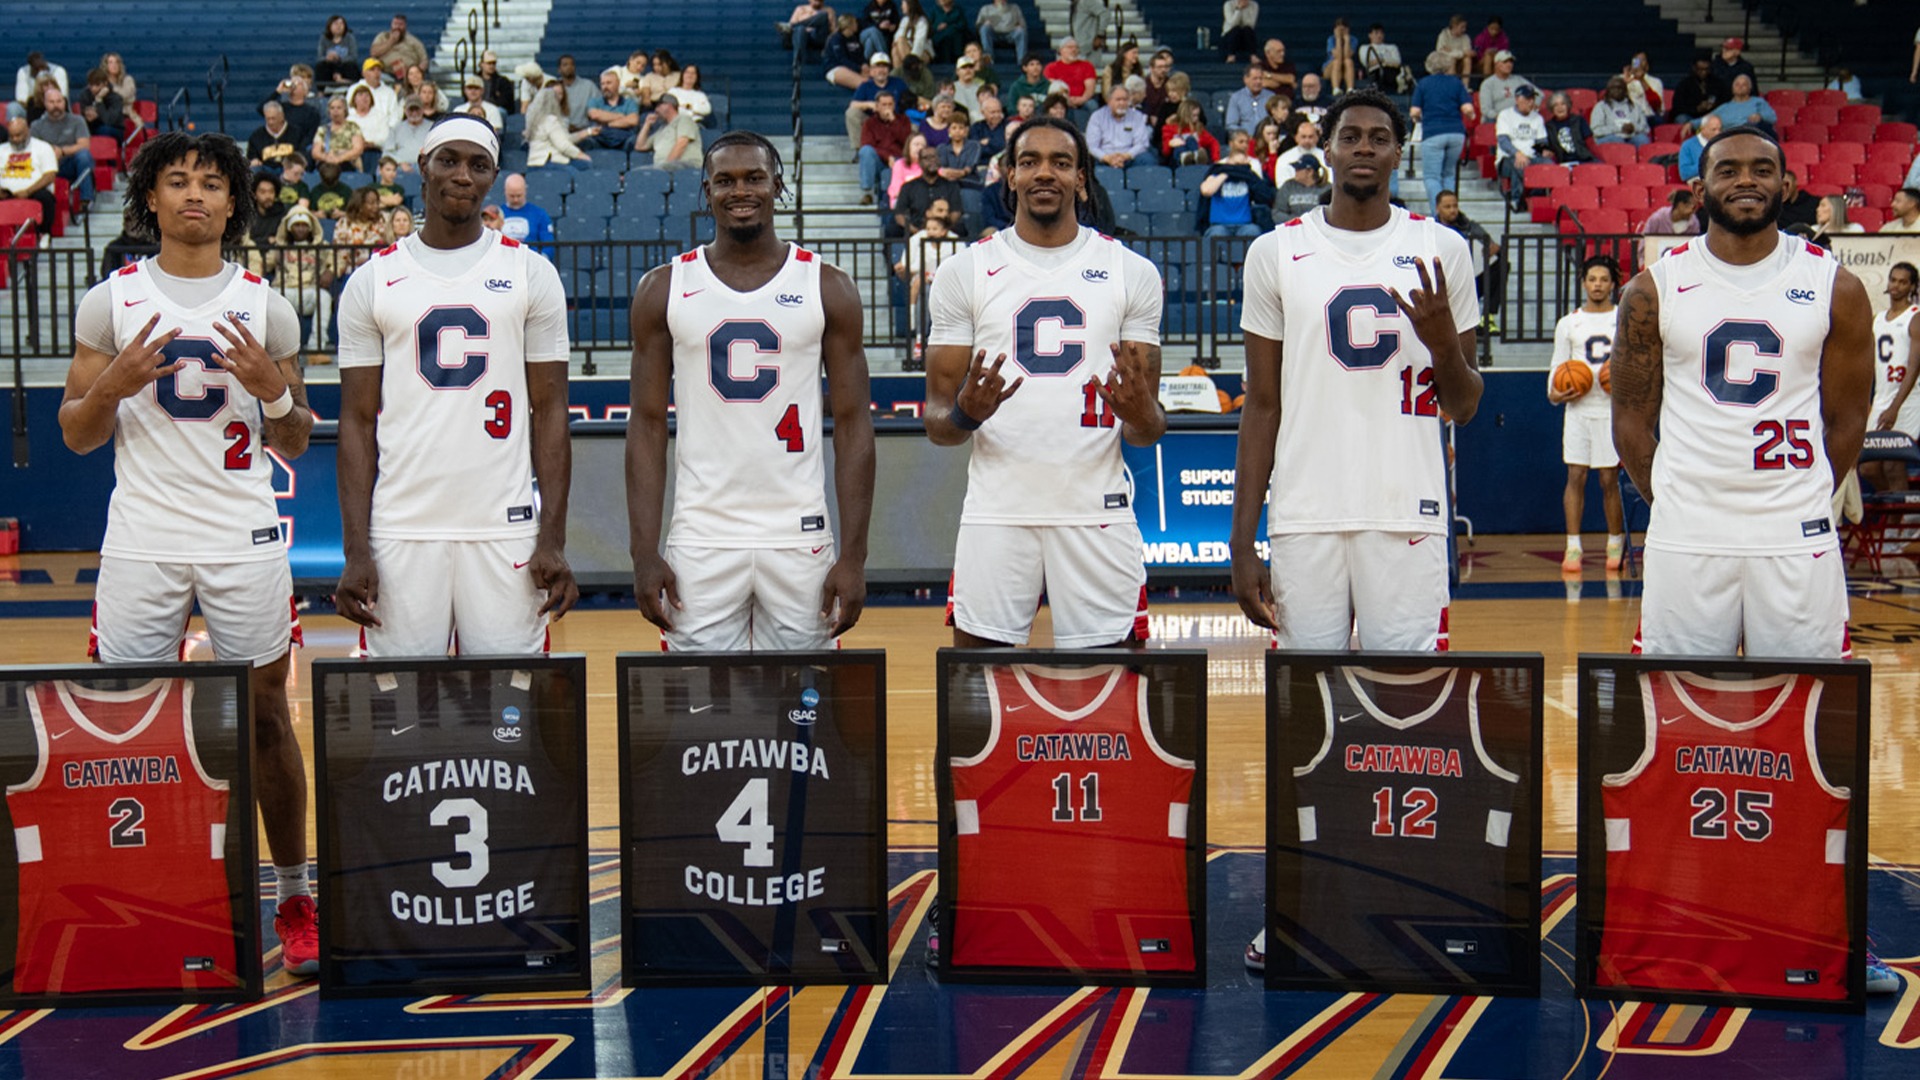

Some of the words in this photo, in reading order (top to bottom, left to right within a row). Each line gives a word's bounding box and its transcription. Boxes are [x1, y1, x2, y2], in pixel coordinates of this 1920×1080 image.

[488, 279, 512, 289] SAC
[1086, 269, 1109, 280] SAC
[780, 294, 803, 304] SAC
[1790, 289, 1815, 301] SAC
[415, 304, 490, 390] C
[1013, 296, 1086, 377] C
[1325, 284, 1401, 371] C
[706, 319, 781, 403] C
[1585, 335, 1612, 365] C
[1701, 318, 1784, 408] C
[1878, 334, 1893, 363] C
[153, 336, 229, 422] C
[1168, 383, 1208, 391] BASKETBALL
[1401, 366, 1439, 417] 12
[1887, 365, 1906, 383] 23
[484, 390, 512, 439] 3
[775, 404, 804, 452] 4
[223, 421, 252, 470] 2
[1753, 420, 1815, 470] 25
[1863, 437, 1913, 449] CATAWBA
[1180, 469, 1236, 485] SUPPO
[1181, 490, 1234, 505] STUDE
[1142, 541, 1232, 563] WBA.ED
[497, 727, 521, 738] SAC
[793, 710, 817, 721] SAC
[682, 739, 829, 779] CATAWBA
[1017, 734, 1131, 761] CATAWBA
[1345, 744, 1463, 777] CATAWBA
[1676, 746, 1794, 781] CATAWBA
[63, 756, 181, 788] CATAWBA
[383, 759, 536, 802] CATAWBA
[1052, 772, 1102, 821] 11
[1372, 787, 1438, 839] 12
[1691, 787, 1772, 842] 25
[109, 797, 146, 847] 2
[715, 778, 774, 867] 4
[430, 798, 489, 888] 3
[391, 881, 535, 925] COLLEGE
[685, 865, 825, 905] COLLEGE
